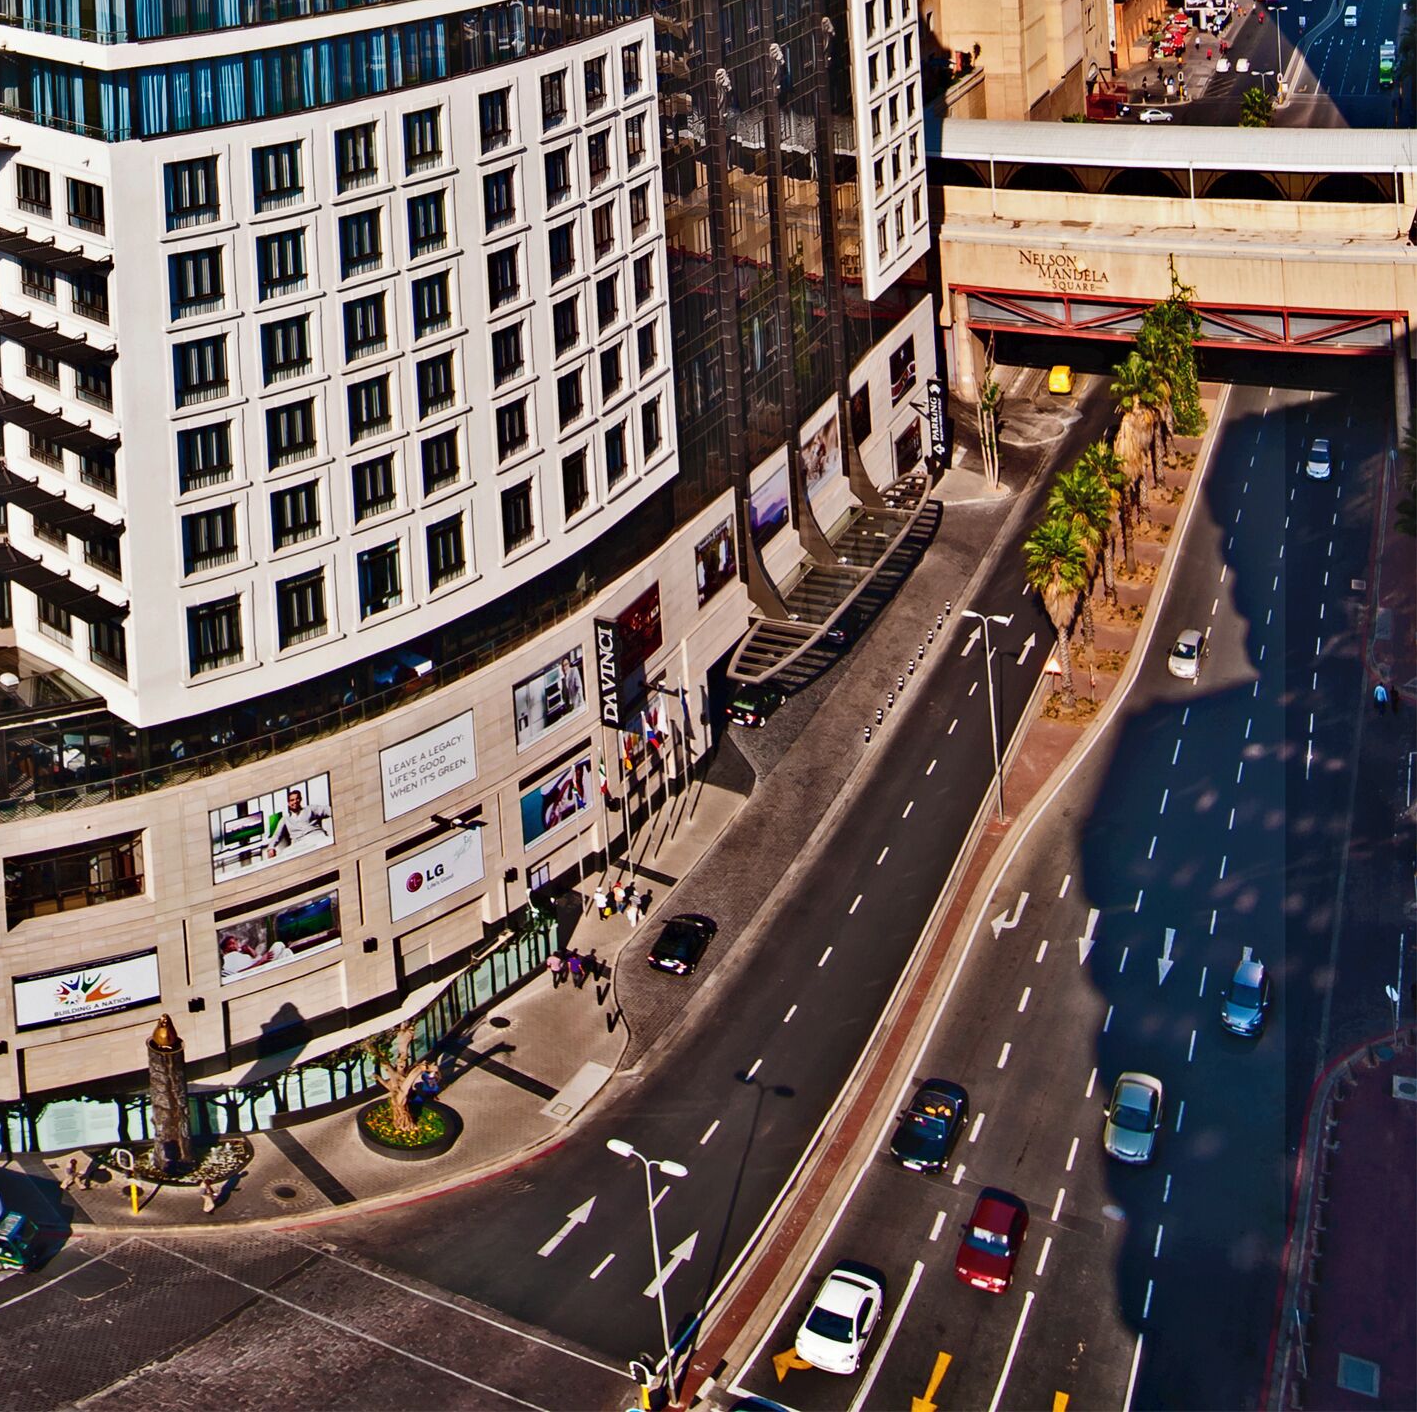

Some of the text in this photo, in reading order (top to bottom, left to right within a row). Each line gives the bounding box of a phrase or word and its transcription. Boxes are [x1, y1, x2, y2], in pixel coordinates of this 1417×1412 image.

[1019, 250, 1077, 268] NELSON
[1038, 264, 1109, 282] MANDELA
[1052, 280, 1095, 292] SQUARE
[931, 397, 940, 441] PARKING
[388, 756, 418, 775] LEAVE
[420, 752, 426, 760] A
[389, 755, 446, 788] LIFE'S GOOD
[390, 781, 418, 799] WHEN
[420, 772, 436, 786] IT'S
[426, 864, 444, 881] LG
[53, 1005, 91, 1017] BUILDING
[102, 996, 132, 1007] NATION
